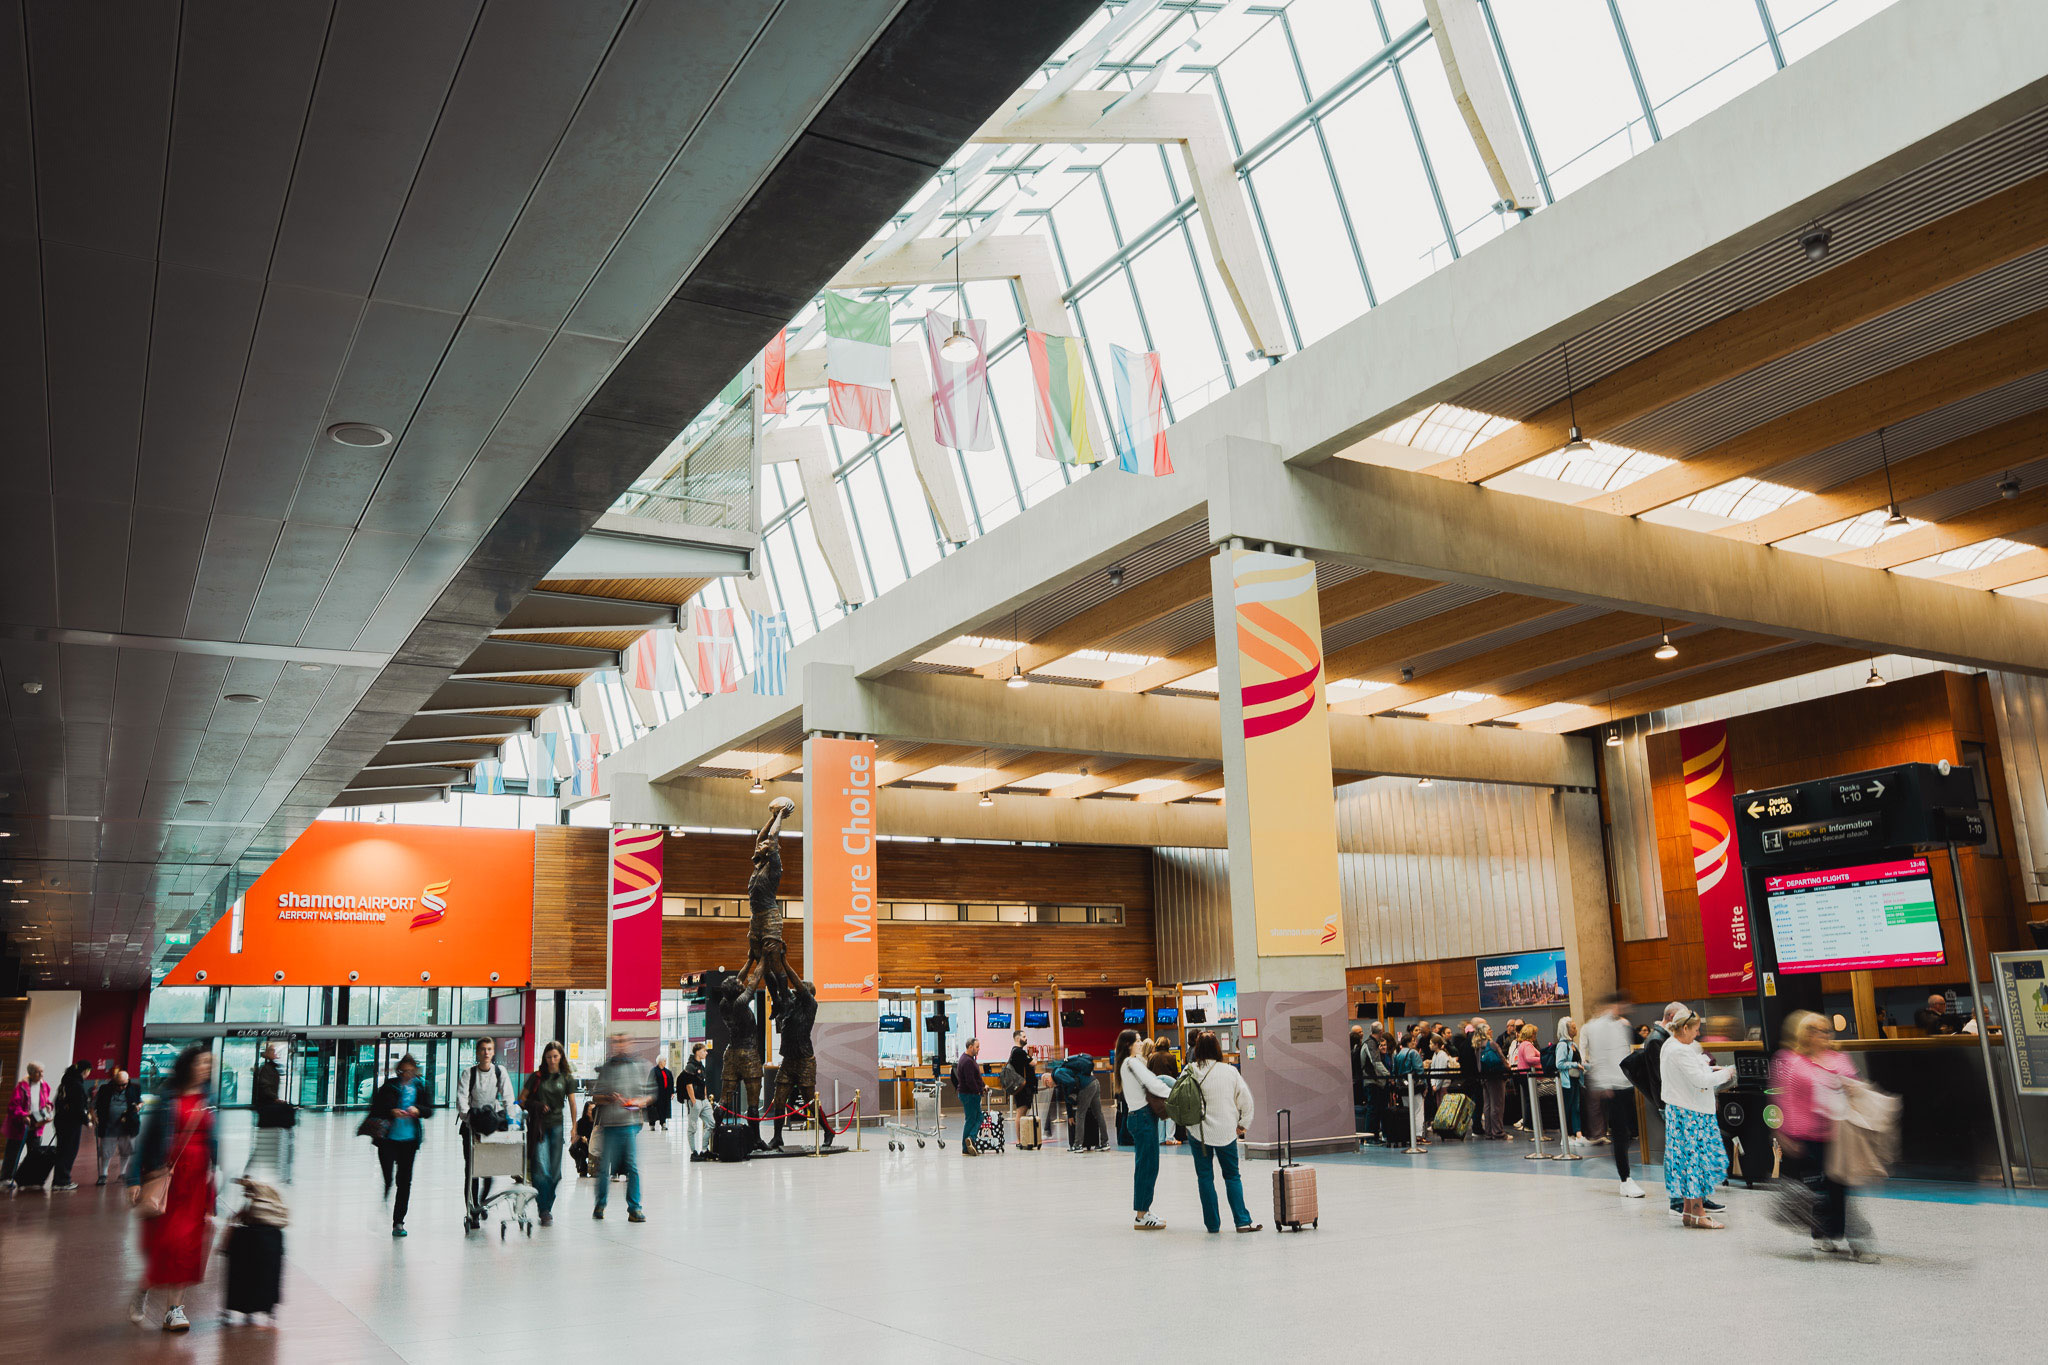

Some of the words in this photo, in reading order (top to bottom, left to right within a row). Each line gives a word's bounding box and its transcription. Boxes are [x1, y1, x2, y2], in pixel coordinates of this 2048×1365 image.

[1840, 784, 1860, 793] Desks
[841, 754, 871, 855] Choice
[1769, 797, 1788, 806] Desks
[1841, 792, 1862, 803] 1-10
[1767, 803, 1793, 816] 11-20
[1787, 829, 1811, 839] Check
[1829, 819, 1873, 832] Information
[1786, 877, 1821, 887] DEPARTING
[1823, 873, 1850, 883] FLIGHTS
[278, 891, 356, 909] shannon
[358, 896, 416, 910] AIRPORT
[843, 864, 872, 943] More
[278, 910, 318, 920] AERFORT
[319, 911, 332, 920] NA
[333, 910, 386, 922] sionainne
[1731, 906, 1748, 950] fáilte
[2004, 971, 2015, 988] AIR
[2008, 990, 2026, 1048] PASSENGER
[387, 1031, 414, 1039] COACH
[2018, 1049, 2032, 1086] RIGHTS
